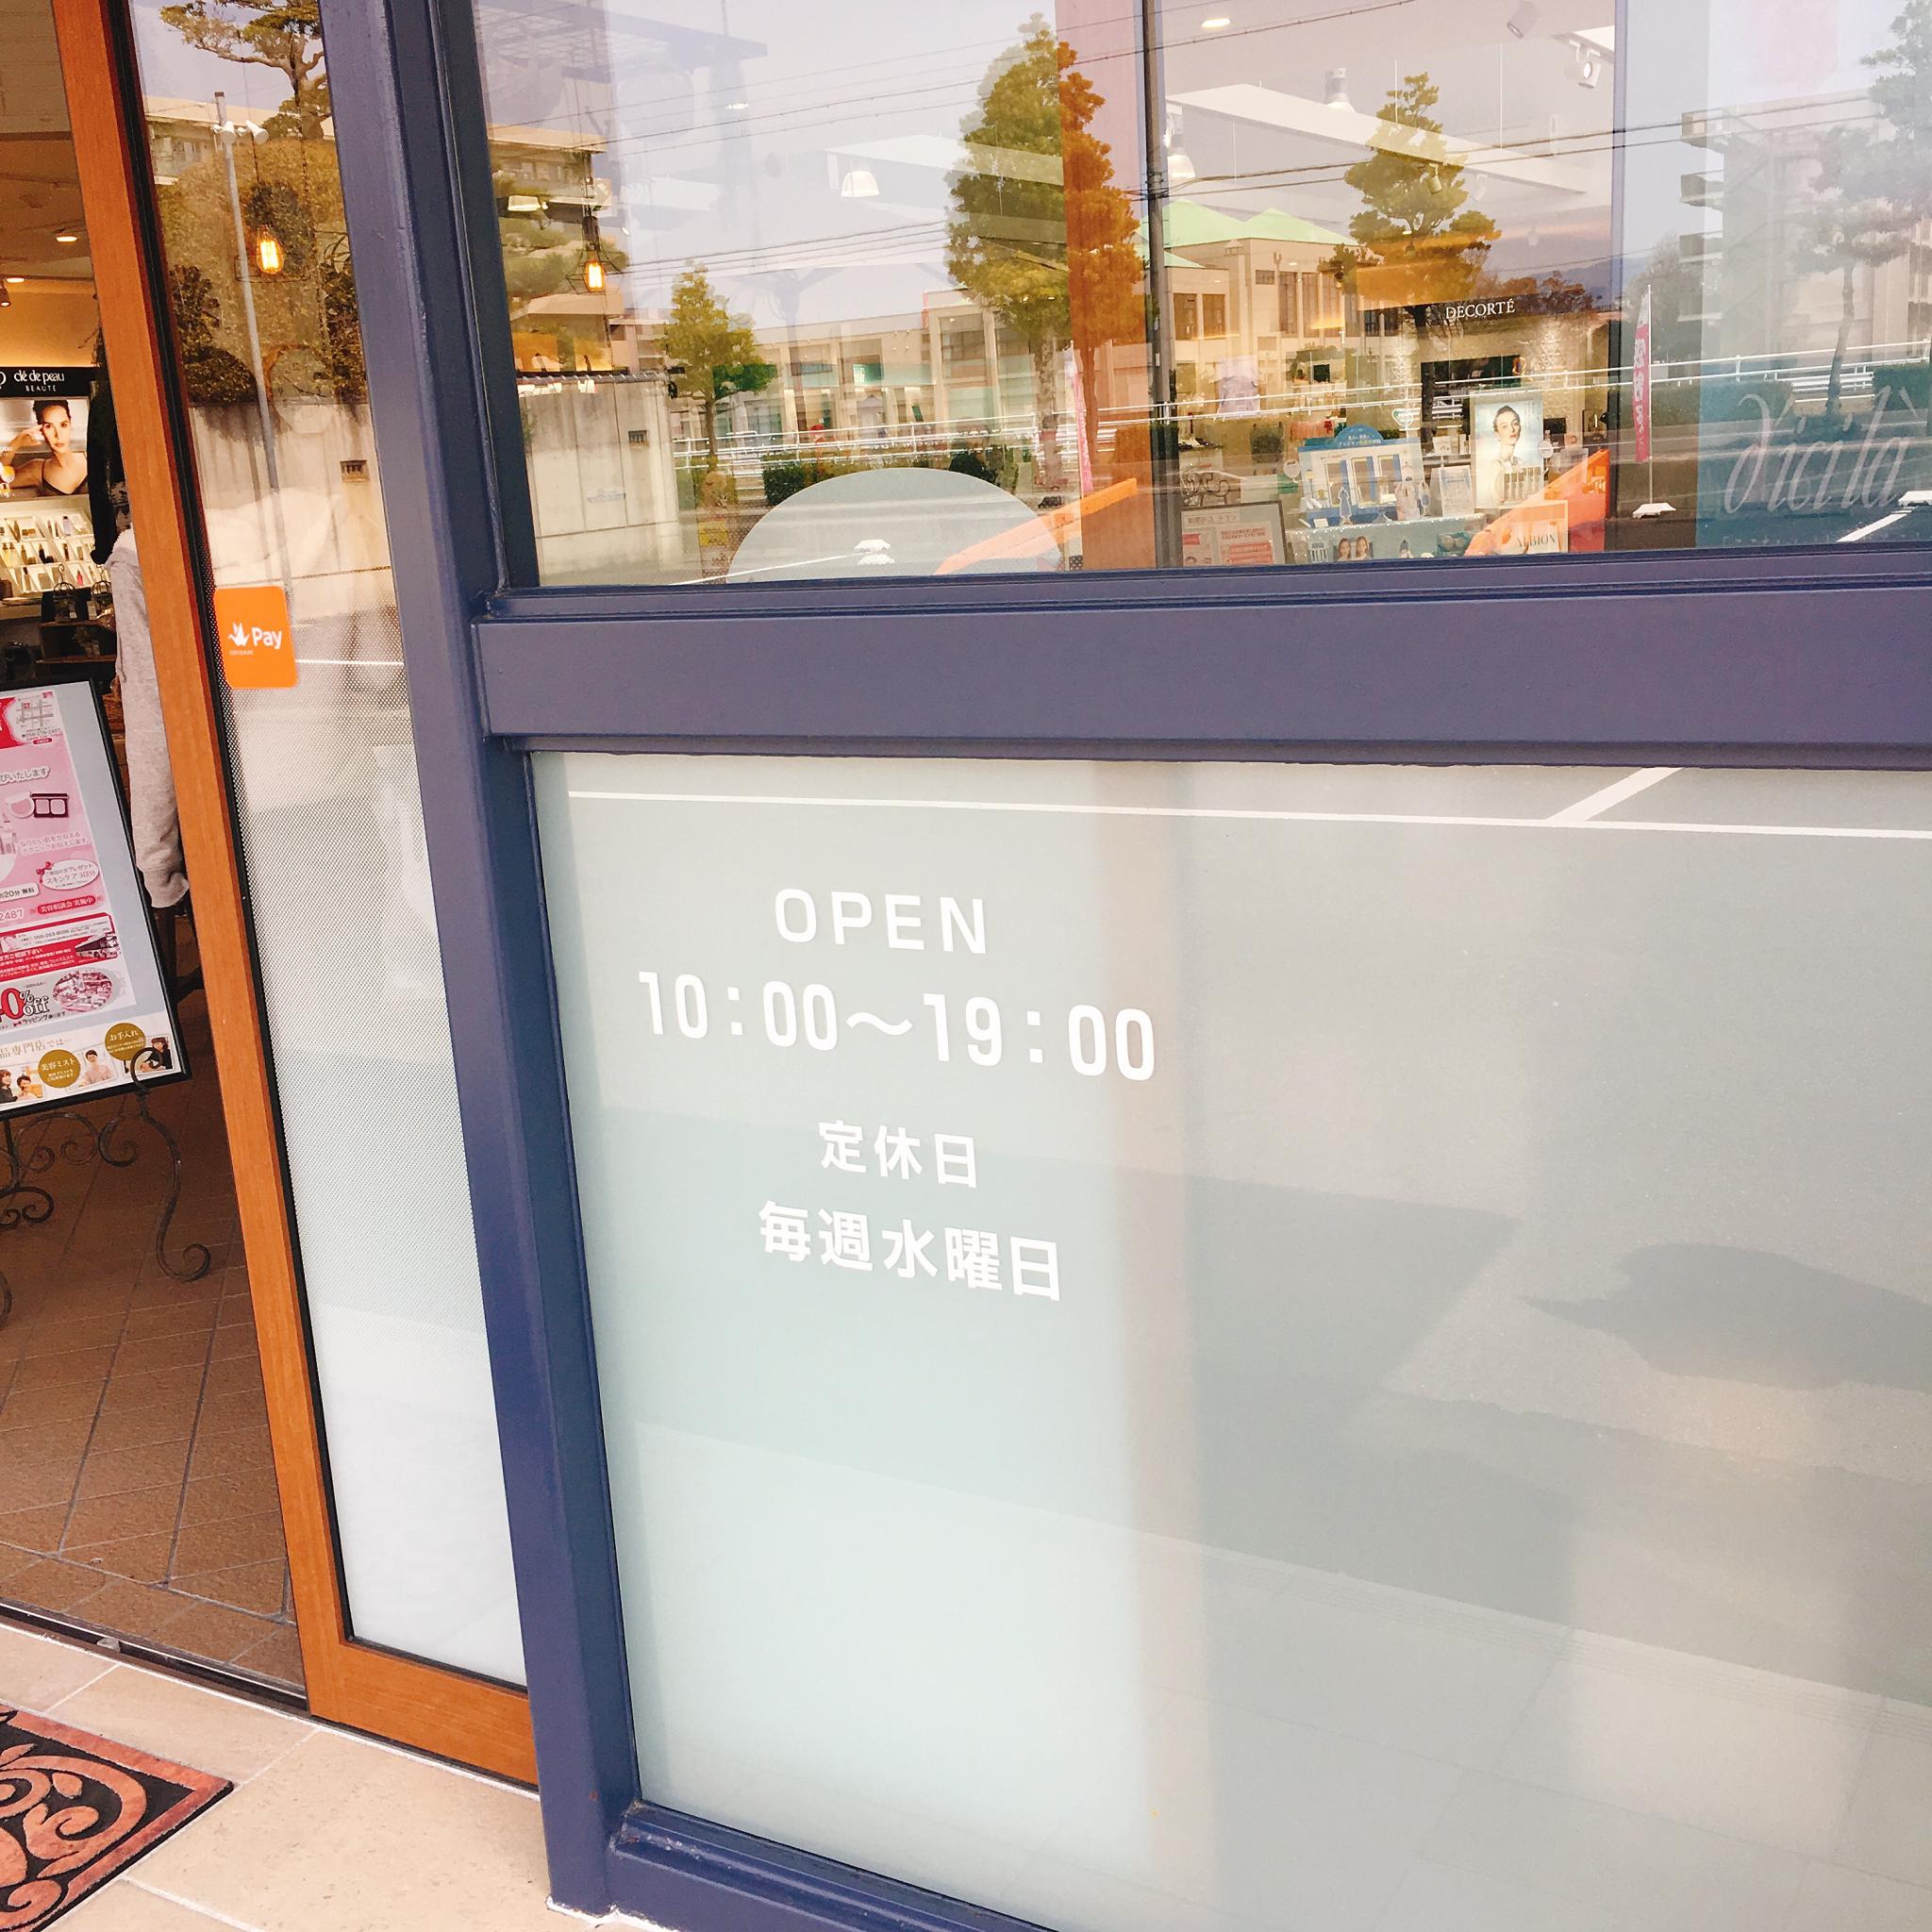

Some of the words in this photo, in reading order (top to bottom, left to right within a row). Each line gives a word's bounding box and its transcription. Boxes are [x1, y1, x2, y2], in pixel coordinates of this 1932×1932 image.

[28, 370, 42, 382] de
[42, 372, 65, 385] peau
[251, 627, 283, 650] Pay
[774, 888, 987, 955] OPEN
[23, 996, 50, 1017] off
[109, 1030, 140, 1041] お手入れ
[42, 1058, 75, 1072] 美容ミスト
[818, 1119, 977, 1189] 定休日
[758, 1200, 1061, 1302] 毎週水曜日
